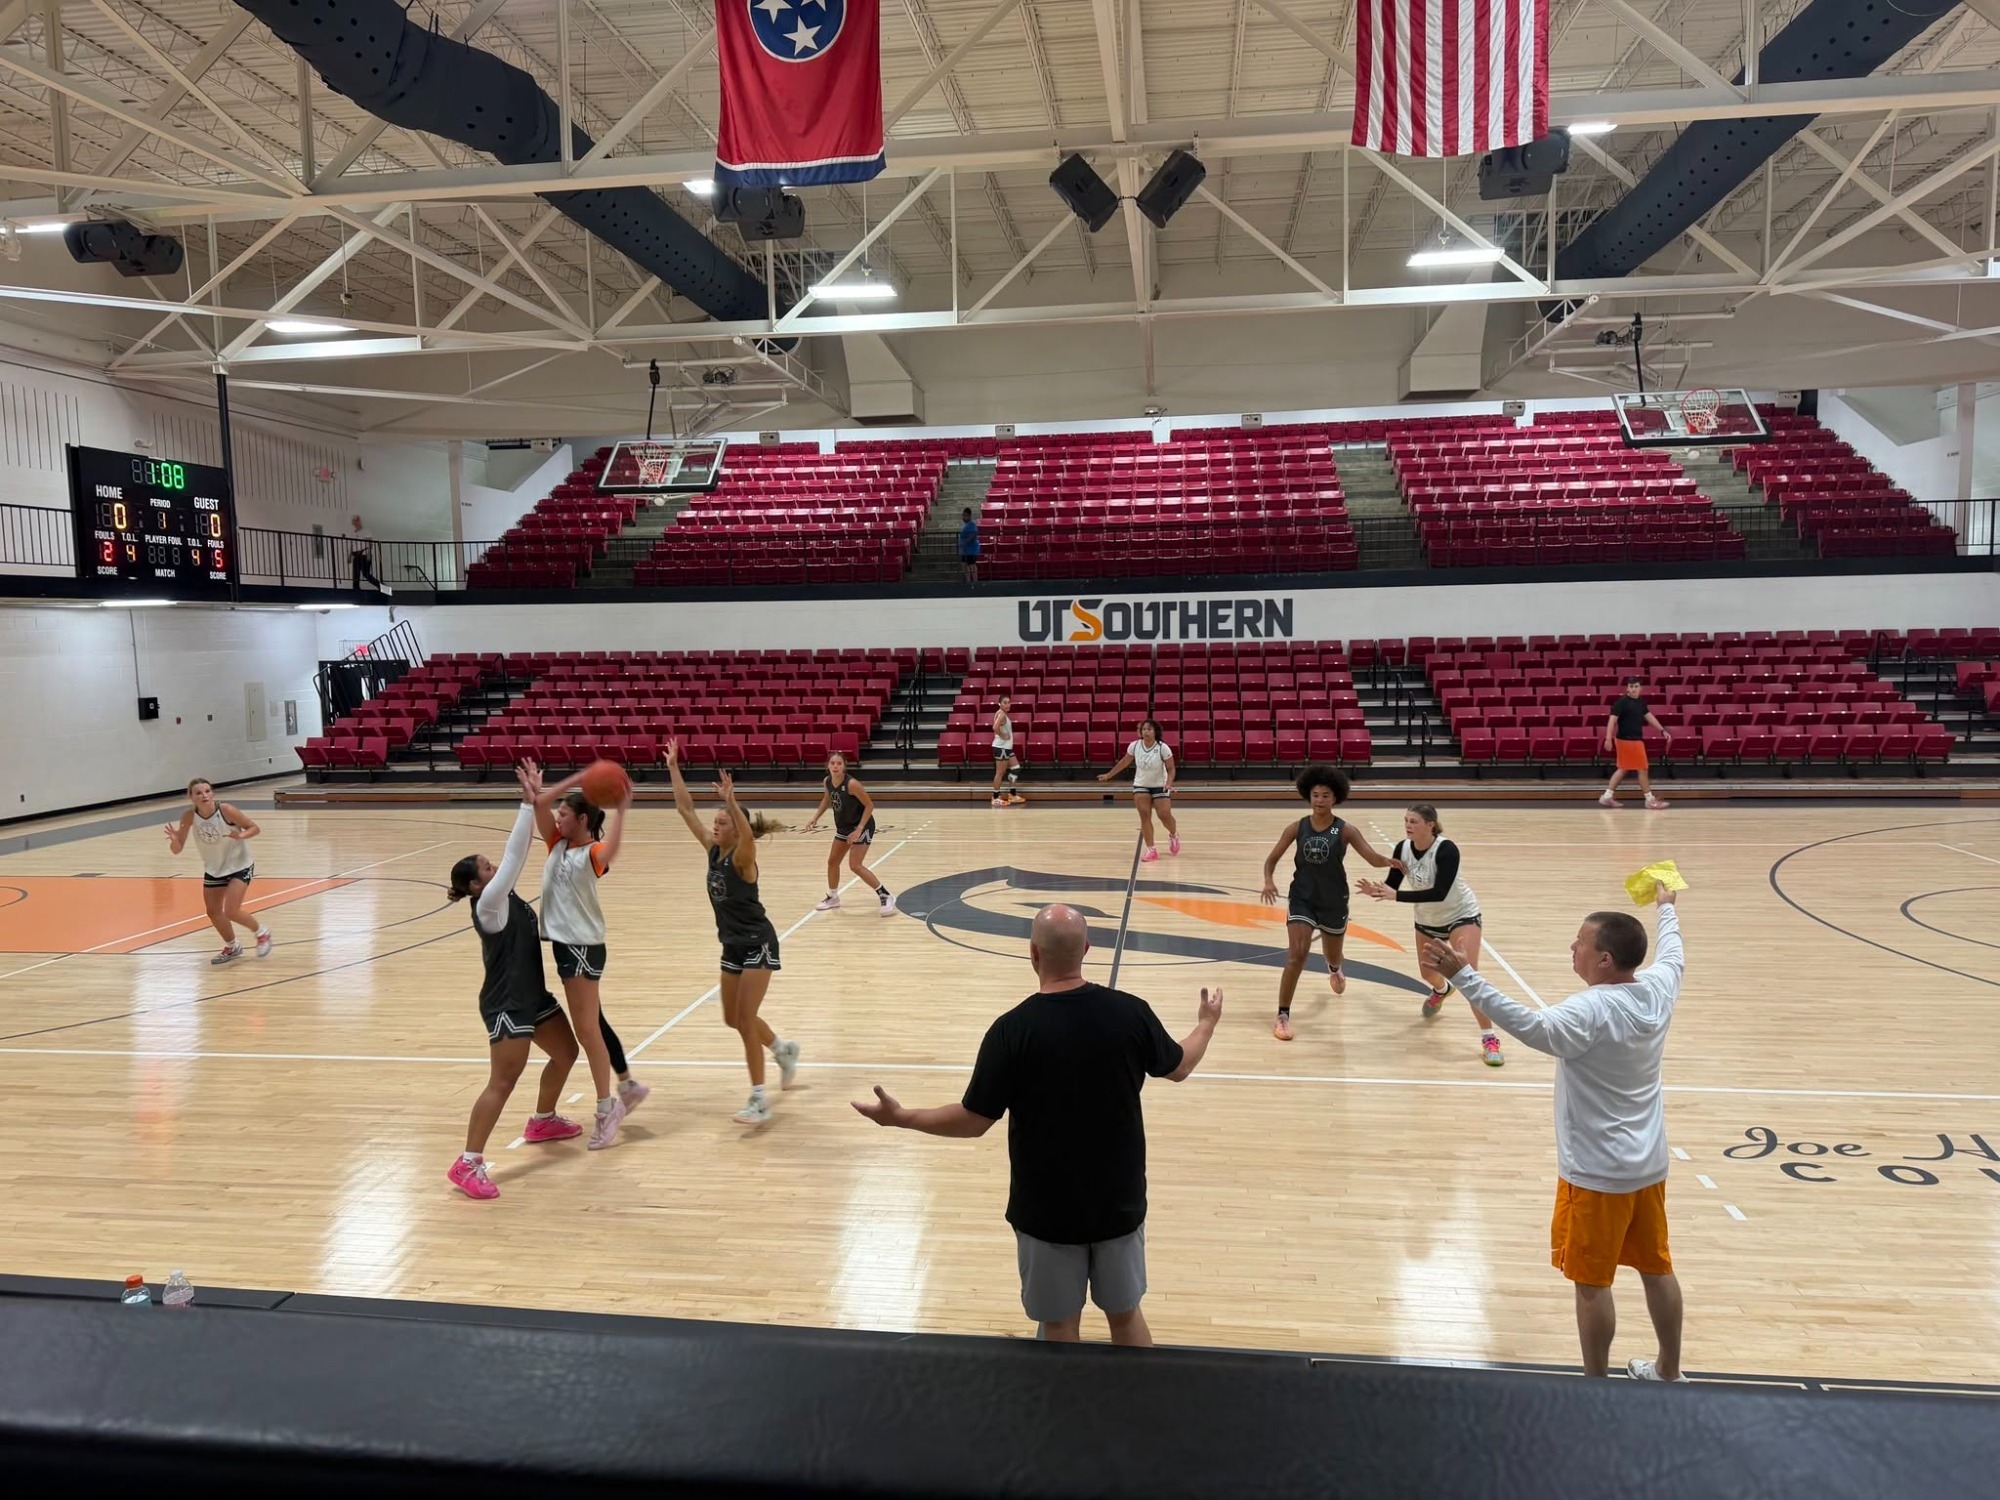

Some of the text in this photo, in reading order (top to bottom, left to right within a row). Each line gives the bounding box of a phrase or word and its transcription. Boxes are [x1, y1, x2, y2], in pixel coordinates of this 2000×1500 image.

[151, 462, 184, 489] 1:08
[95, 484, 123, 499] HOME
[149, 498, 171, 508] PERIOD
[193, 496, 219, 510] GUEST
[114, 503, 127, 529] 0
[210, 513, 221, 538] 0
[94, 530, 115, 540] FOULS
[144, 534, 182, 546] PLAYER FOUL
[103, 541, 113, 562] 2
[207, 539, 224, 549] FOULS
[126, 544, 136, 562] 4
[214, 549, 223, 568] 5
[97, 566, 118, 575] SCORE
[155, 568, 176, 577] MATCH
[209, 571, 227, 580] SCORE
[1723, 1126, 1872, 1159] Joe
[1779, 1162, 2000, 1186] CO
